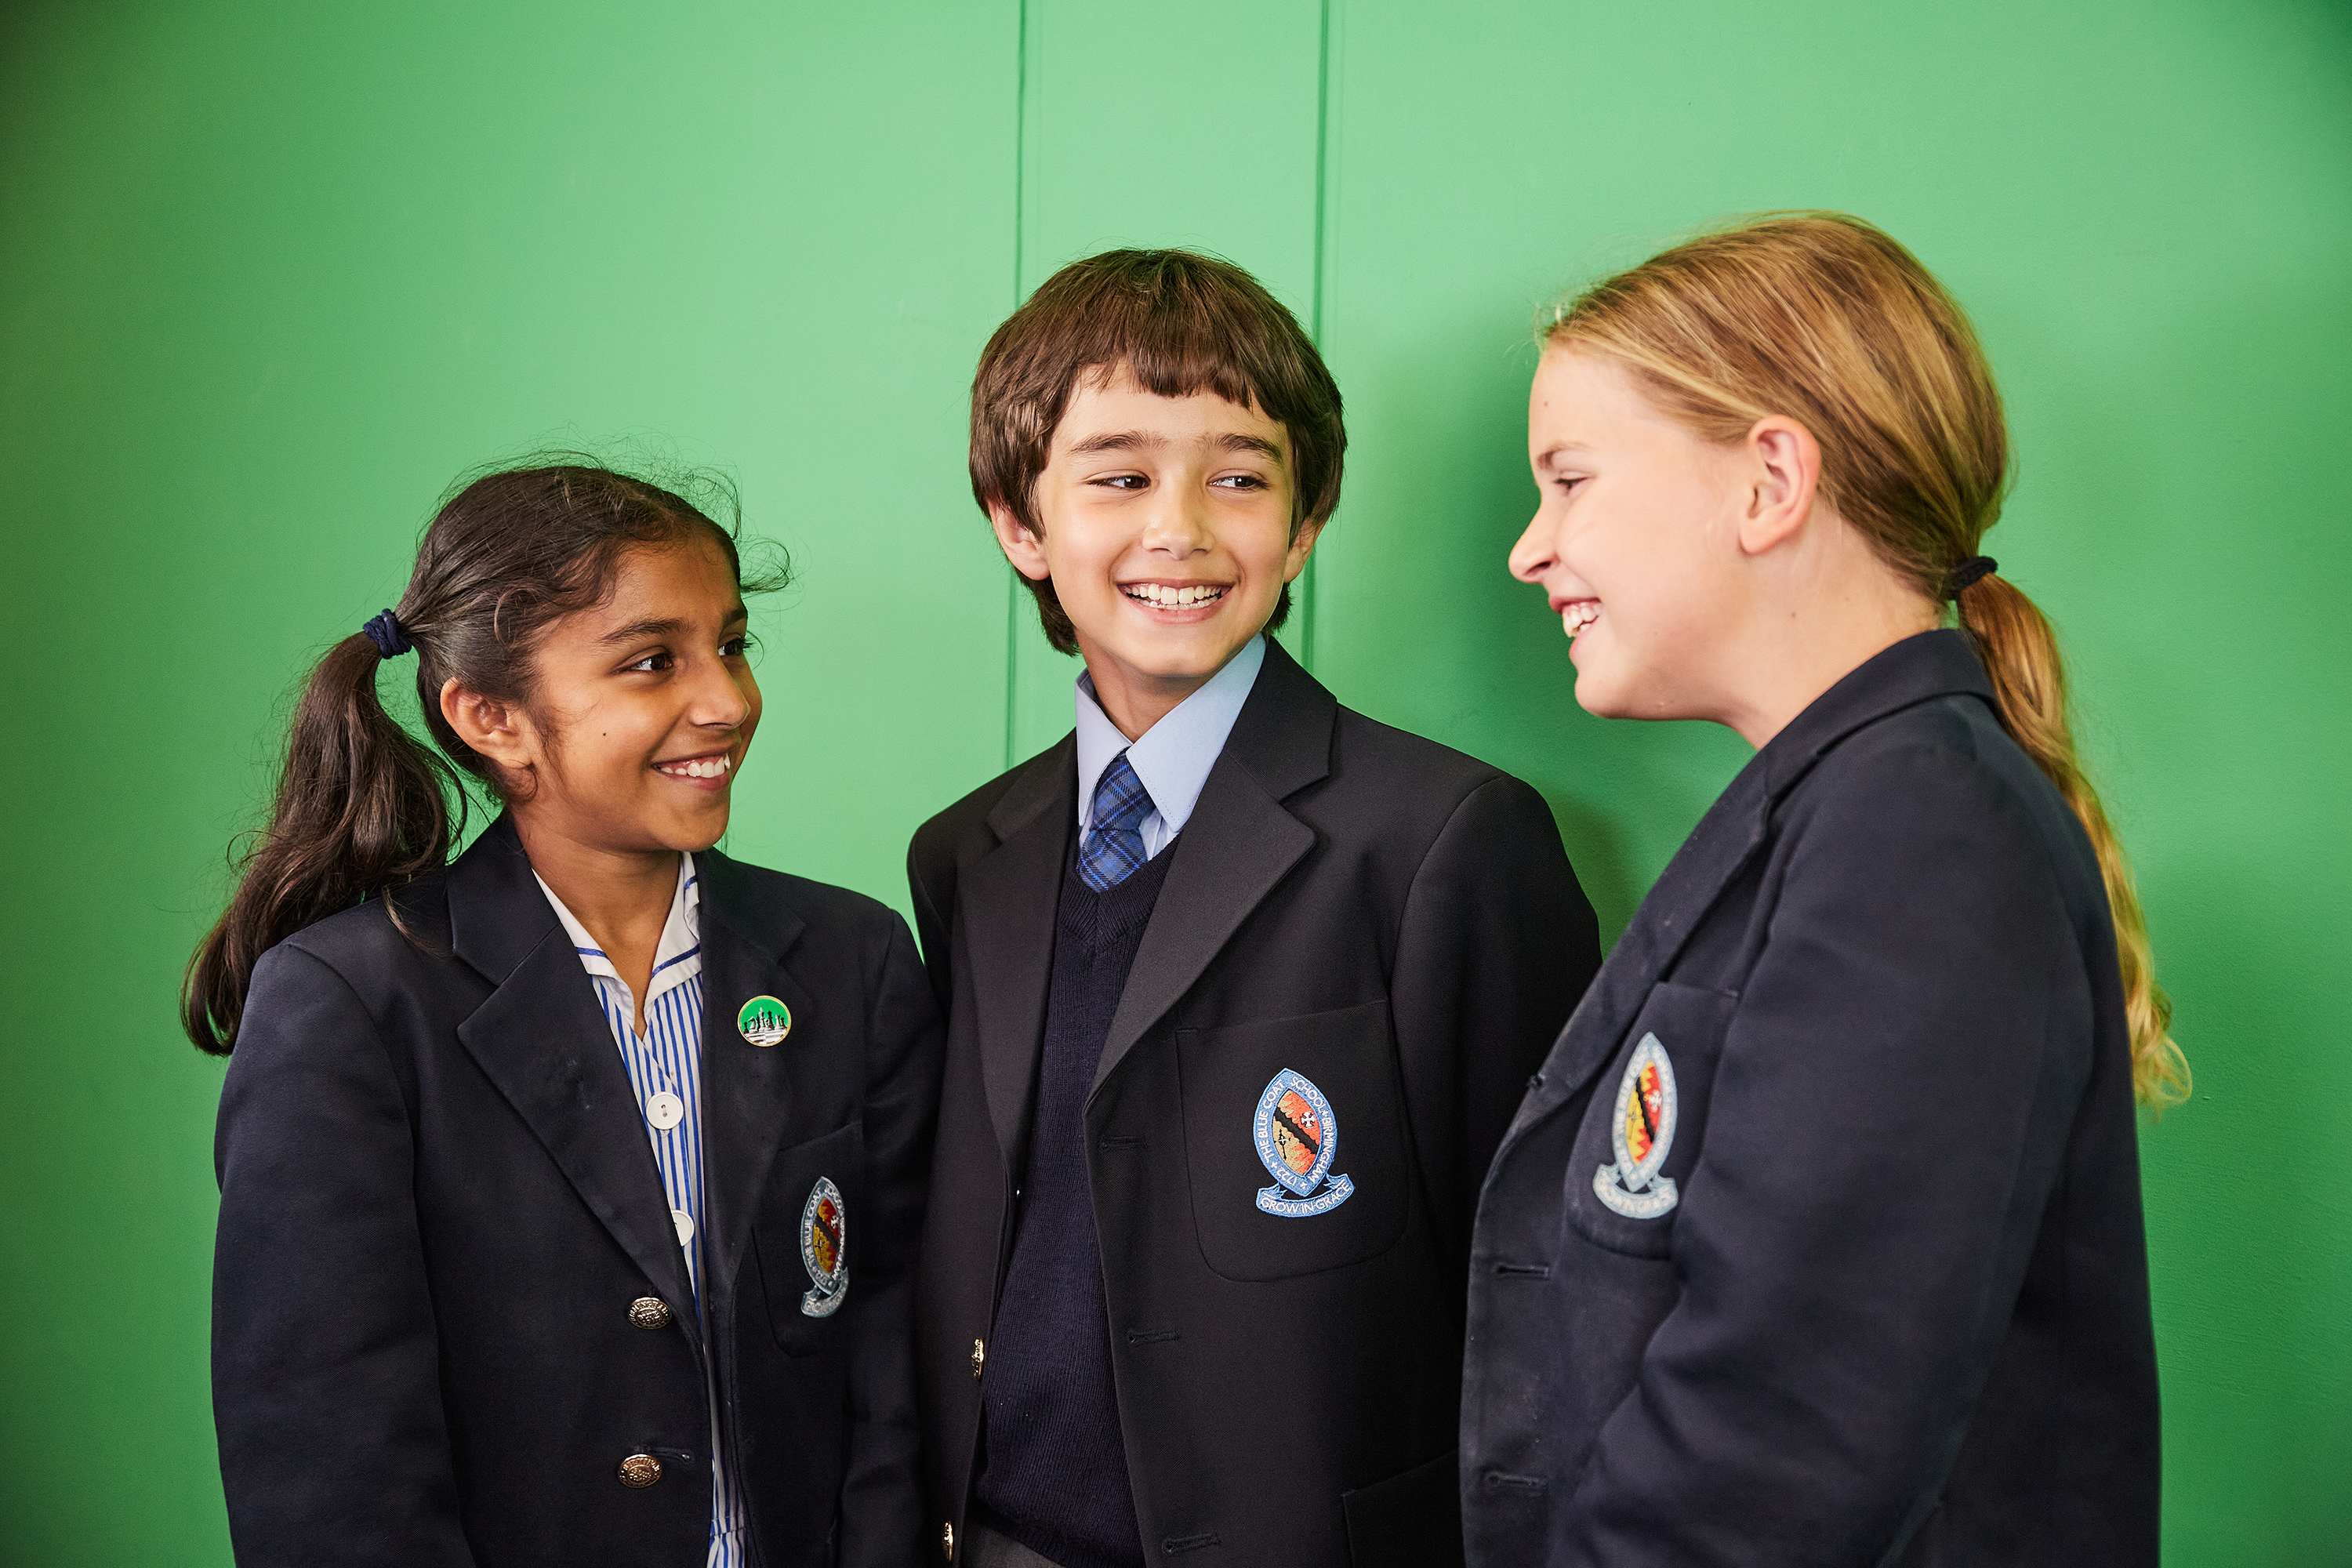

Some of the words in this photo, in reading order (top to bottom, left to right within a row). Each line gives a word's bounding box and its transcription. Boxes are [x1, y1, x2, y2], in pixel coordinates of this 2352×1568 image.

[1263, 1079, 1286, 1109] COAT
[1290, 1076, 1327, 1112] SCHOOL
[1258, 1110, 1269, 1138] BLUE
[1258, 1140, 1275, 1163] THE
[1307, 1116, 1334, 1184] BIRMINGHAM
[1276, 1167, 1298, 1186] 1722
[807, 1187, 822, 1217] COAT
[1260, 1197, 1298, 1214] GROW
[1315, 1182, 1352, 1210] GRACE
[804, 1219, 813, 1247] BLUE
[804, 1247, 815, 1268] THE
